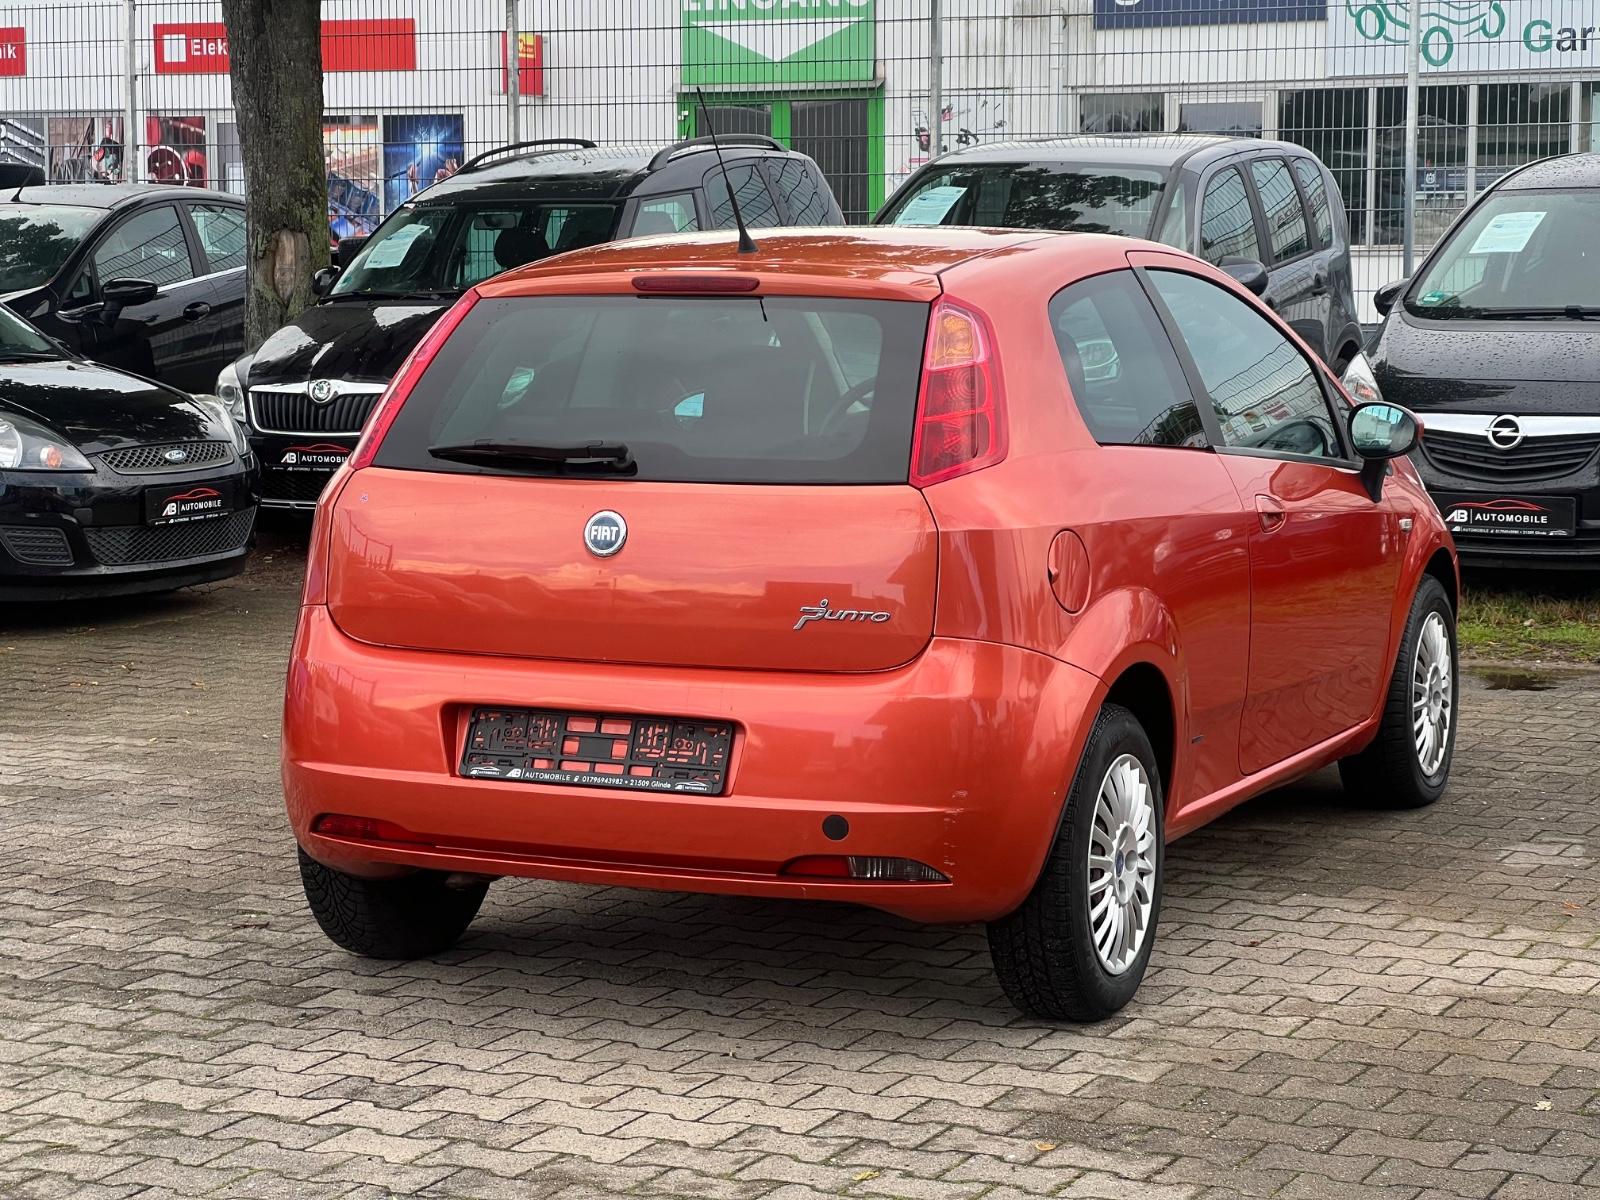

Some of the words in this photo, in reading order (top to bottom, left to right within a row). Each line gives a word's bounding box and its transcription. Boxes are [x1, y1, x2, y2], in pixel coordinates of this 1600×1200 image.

[1523, 19, 1600, 52] Gar
[281, 452, 297, 464] AB
[301, 455, 348, 463] AUTOMOBI
[162, 502, 177, 517] AB
[180, 499, 222, 512] AUTOMOBILE
[1445, 509, 1468, 523] AB
[1474, 512, 1548, 524] AUTOMOBILE
[590, 525, 619, 541] FIAT
[506, 768, 521, 778] AB
[524, 771, 571, 781] AUTOMOBILE
[630, 779, 650, 787] 21509
[651, 780, 671, 789] Glinde
